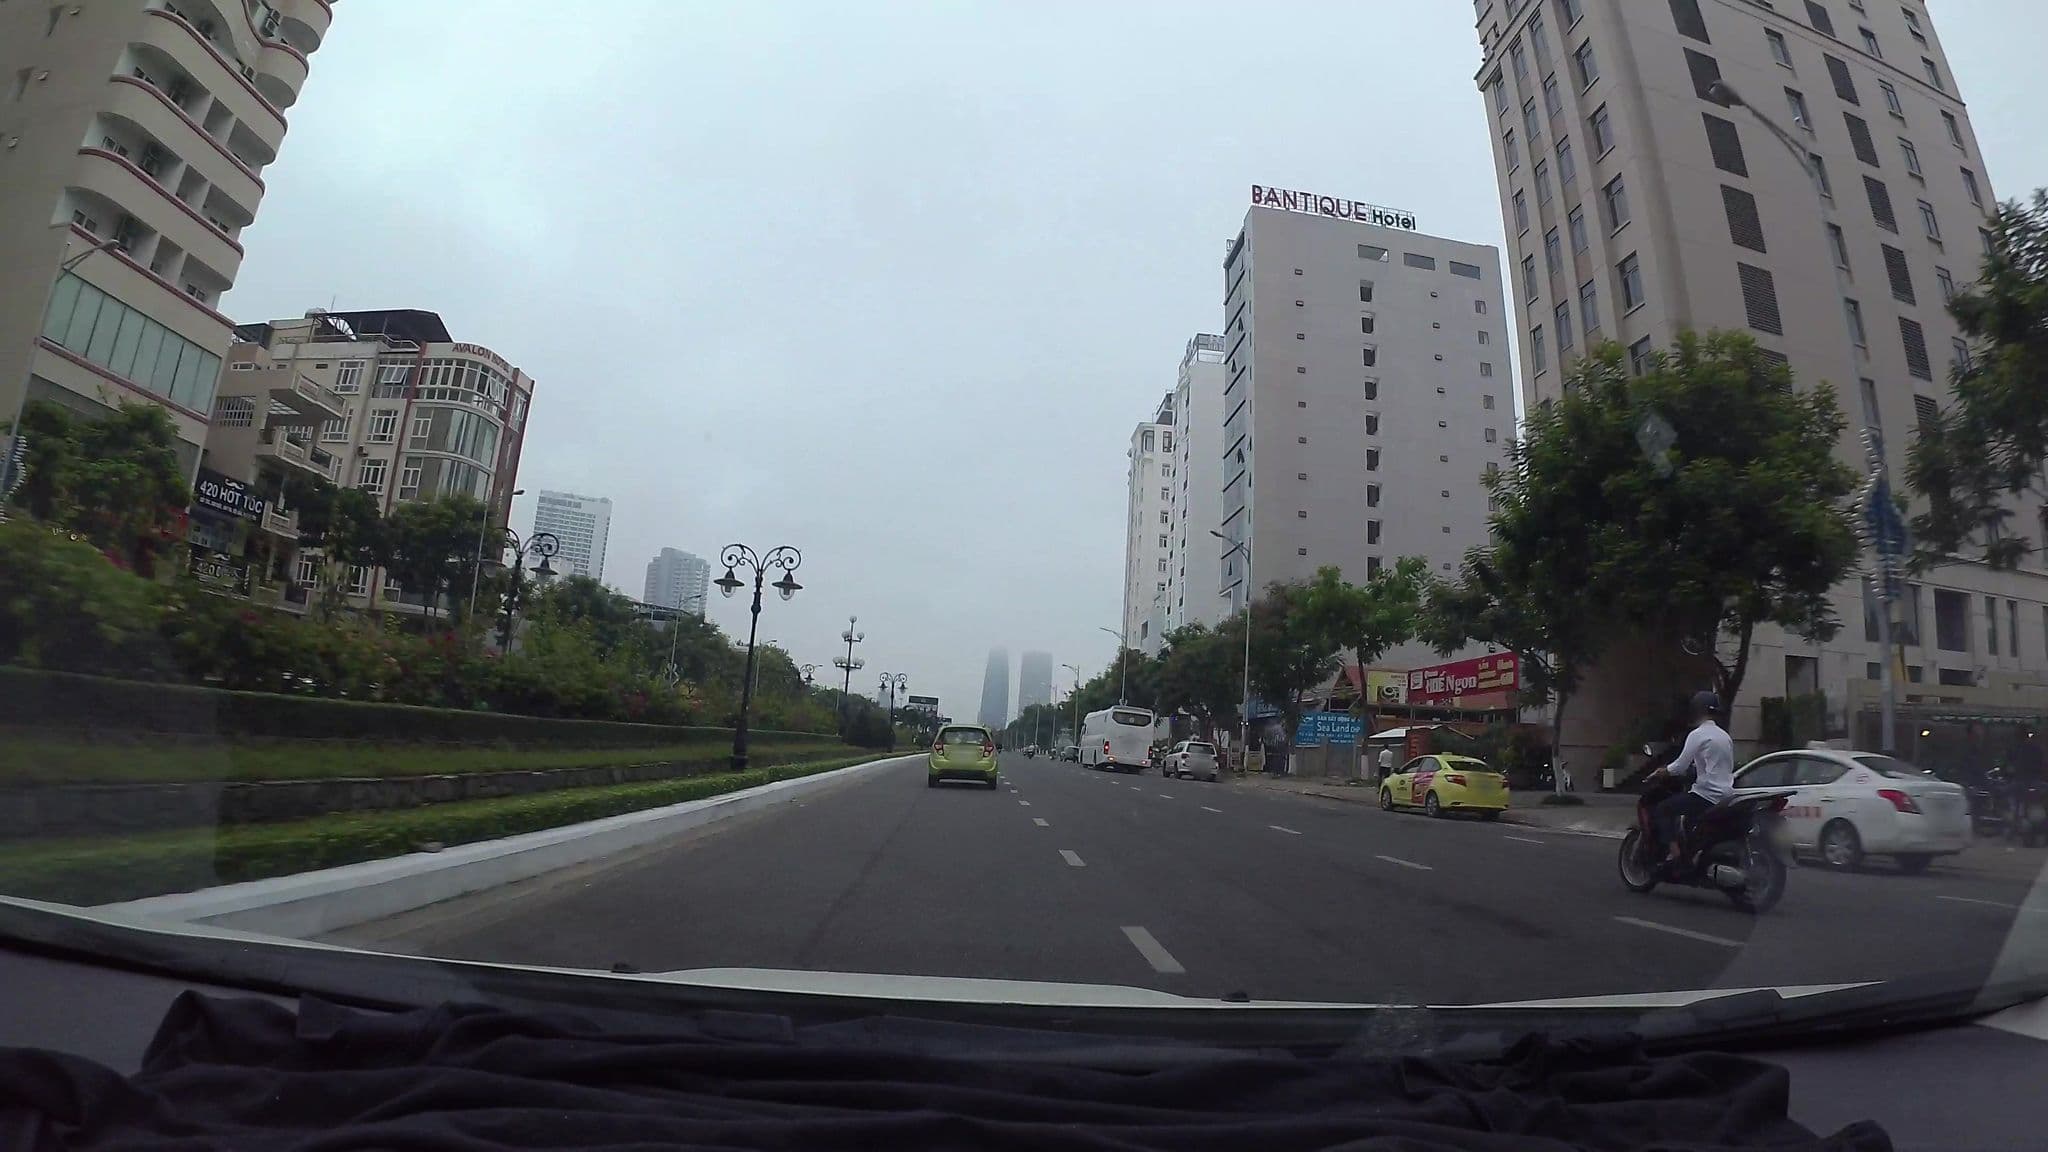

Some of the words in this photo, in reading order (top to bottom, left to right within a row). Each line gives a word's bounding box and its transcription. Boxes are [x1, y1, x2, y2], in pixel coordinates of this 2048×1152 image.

[1252, 185, 1367, 221] BANTIQUE
[1372, 210, 1417, 230] Hotel
[452, 343, 491, 359] AVALON
[200, 480, 219, 498] 420
[1445, 674, 1477, 695] Ngon
[1316, 721, 1330, 732] Sea
[1331, 722, 1350, 733] Land
